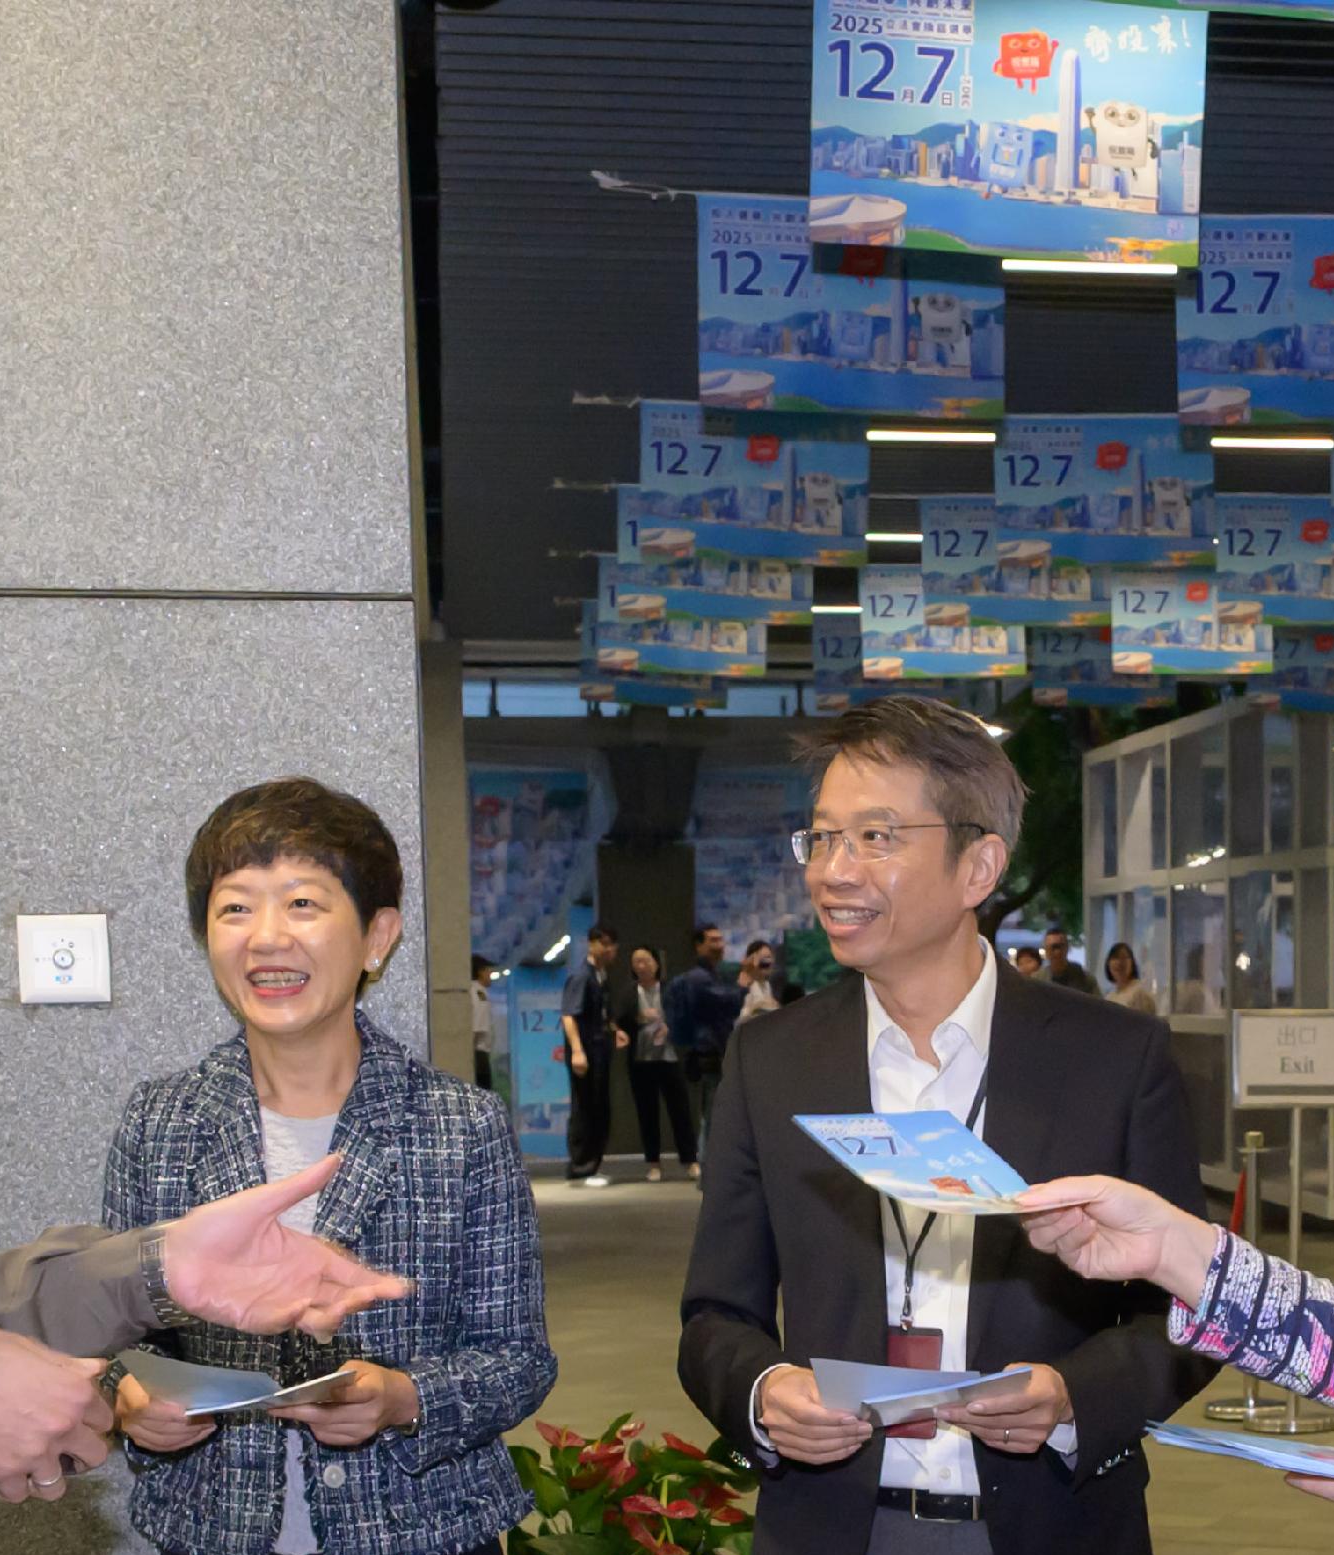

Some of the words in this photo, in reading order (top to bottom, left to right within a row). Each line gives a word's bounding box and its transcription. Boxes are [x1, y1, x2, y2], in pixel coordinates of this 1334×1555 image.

[830, 13, 884, 35] 2025
[1276, 1024, 1317, 1047] 出口
[1279, 1055, 1316, 1074] Exit
